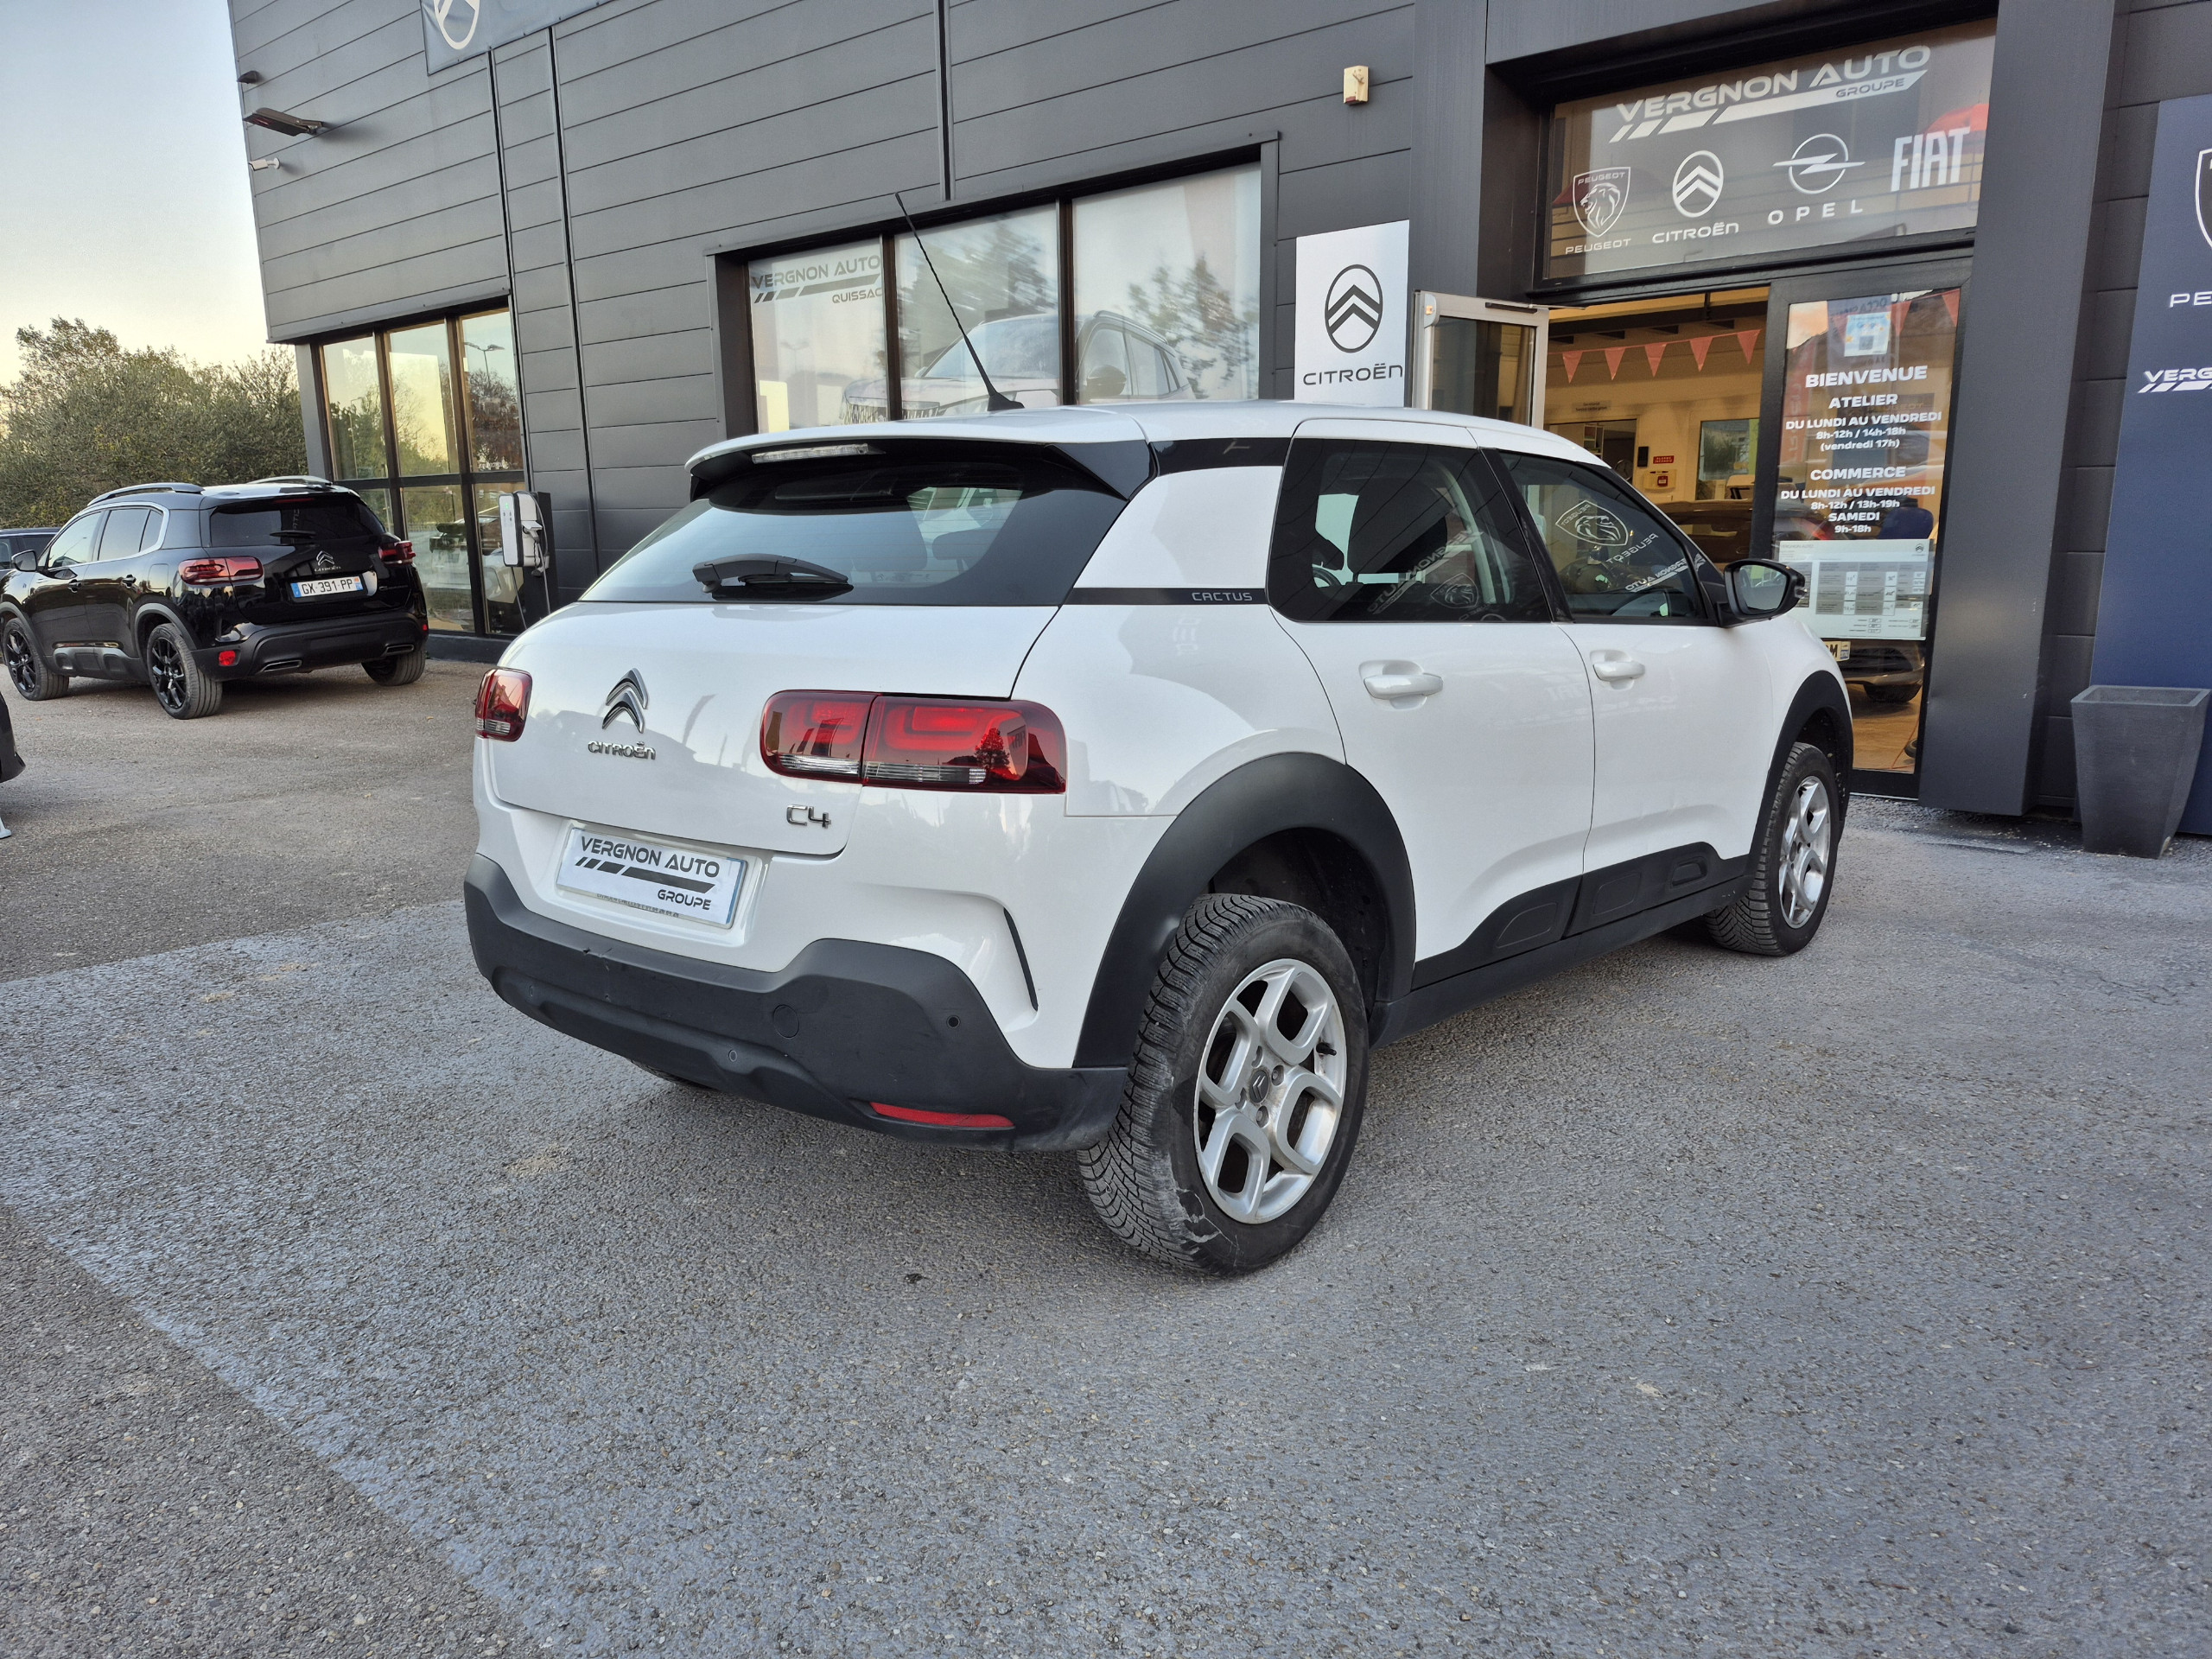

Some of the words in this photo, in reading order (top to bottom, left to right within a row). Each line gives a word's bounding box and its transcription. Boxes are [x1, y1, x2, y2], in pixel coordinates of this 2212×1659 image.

[1616, 69, 1798, 123] VERGNON
[1808, 45, 1931, 90] AUTO
[1835, 78, 1905, 99] GROUPE
[1891, 126, 1971, 193] FIAT
[1577, 172, 1625, 185] PEUGEOT
[1767, 199, 1864, 226] OPEL
[1652, 222, 1739, 245] CITROËN
[1565, 238, 1631, 255] PEUGEOT
[751, 264, 829, 289] VERGNON
[834, 255, 880, 276] AUTO
[832, 288, 882, 303] QUISSAC
[1303, 363, 1403, 386] CITROËN
[1805, 365, 1928, 388] BIENVENUE
[1828, 394, 1898, 409] ATELIER
[1786, 420, 1804, 429] DU
[1807, 417, 1847, 429] LUNDI
[1848, 416, 1869, 427] AU
[1871, 411, 1942, 425] VENDREDI
[1816, 429, 1853, 440] 8h-12h
[1862, 427, 1906, 437] 14h-18h
[1821, 440, 1873, 452] (vendredi
[1876, 439, 1900, 448] 17h)
[1810, 466, 1906, 480] COMMERCE
[1781, 490, 1800, 499] DU
[1801, 489, 1840, 499] LUNDI
[1843, 487, 1864, 498] AU
[1865, 486, 1936, 497] VENDREDI
[1810, 501, 1847, 510] 8h-12h
[1856, 499, 1900, 509] 13h-19h
[1828, 512, 1880, 522] SAMEDI
[1834, 524, 1872, 533] 9h-18h
[1192, 592, 1253, 601] CACTUS
[588, 741, 657, 760] CITROËN
[785, 804, 832, 830] C4
[581, 836, 663, 867] VERGNON
[664, 854, 720, 879] AUTO
[658, 889, 712, 911] GROUPE
